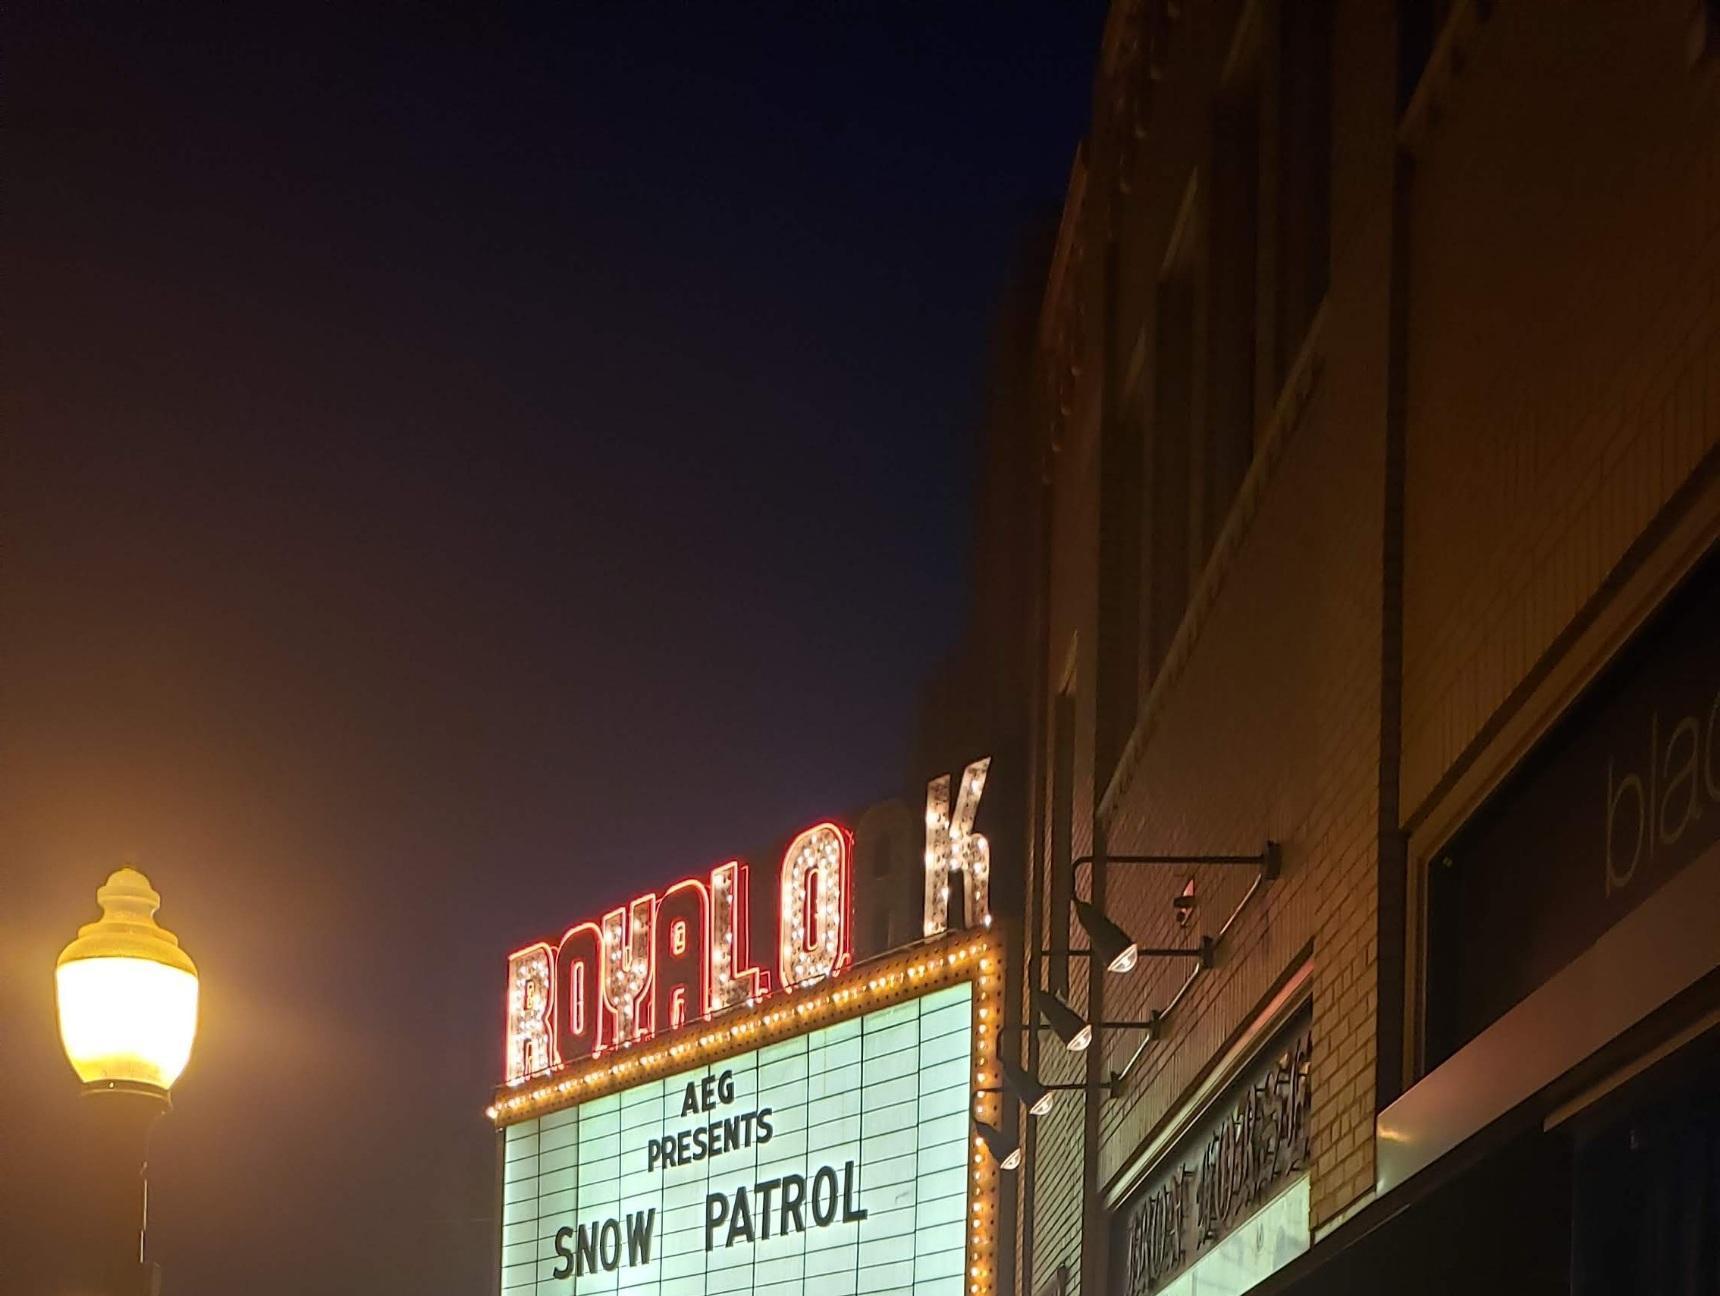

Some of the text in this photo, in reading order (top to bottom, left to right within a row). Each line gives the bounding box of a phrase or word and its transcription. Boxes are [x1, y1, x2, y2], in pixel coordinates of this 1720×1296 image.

[506, 859, 771, 1088] ROYAL
[648, 1107, 774, 1172] PRESENTS
[681, 1069, 734, 1118] AEG
[553, 1160, 868, 1280] SNOW PATROL
